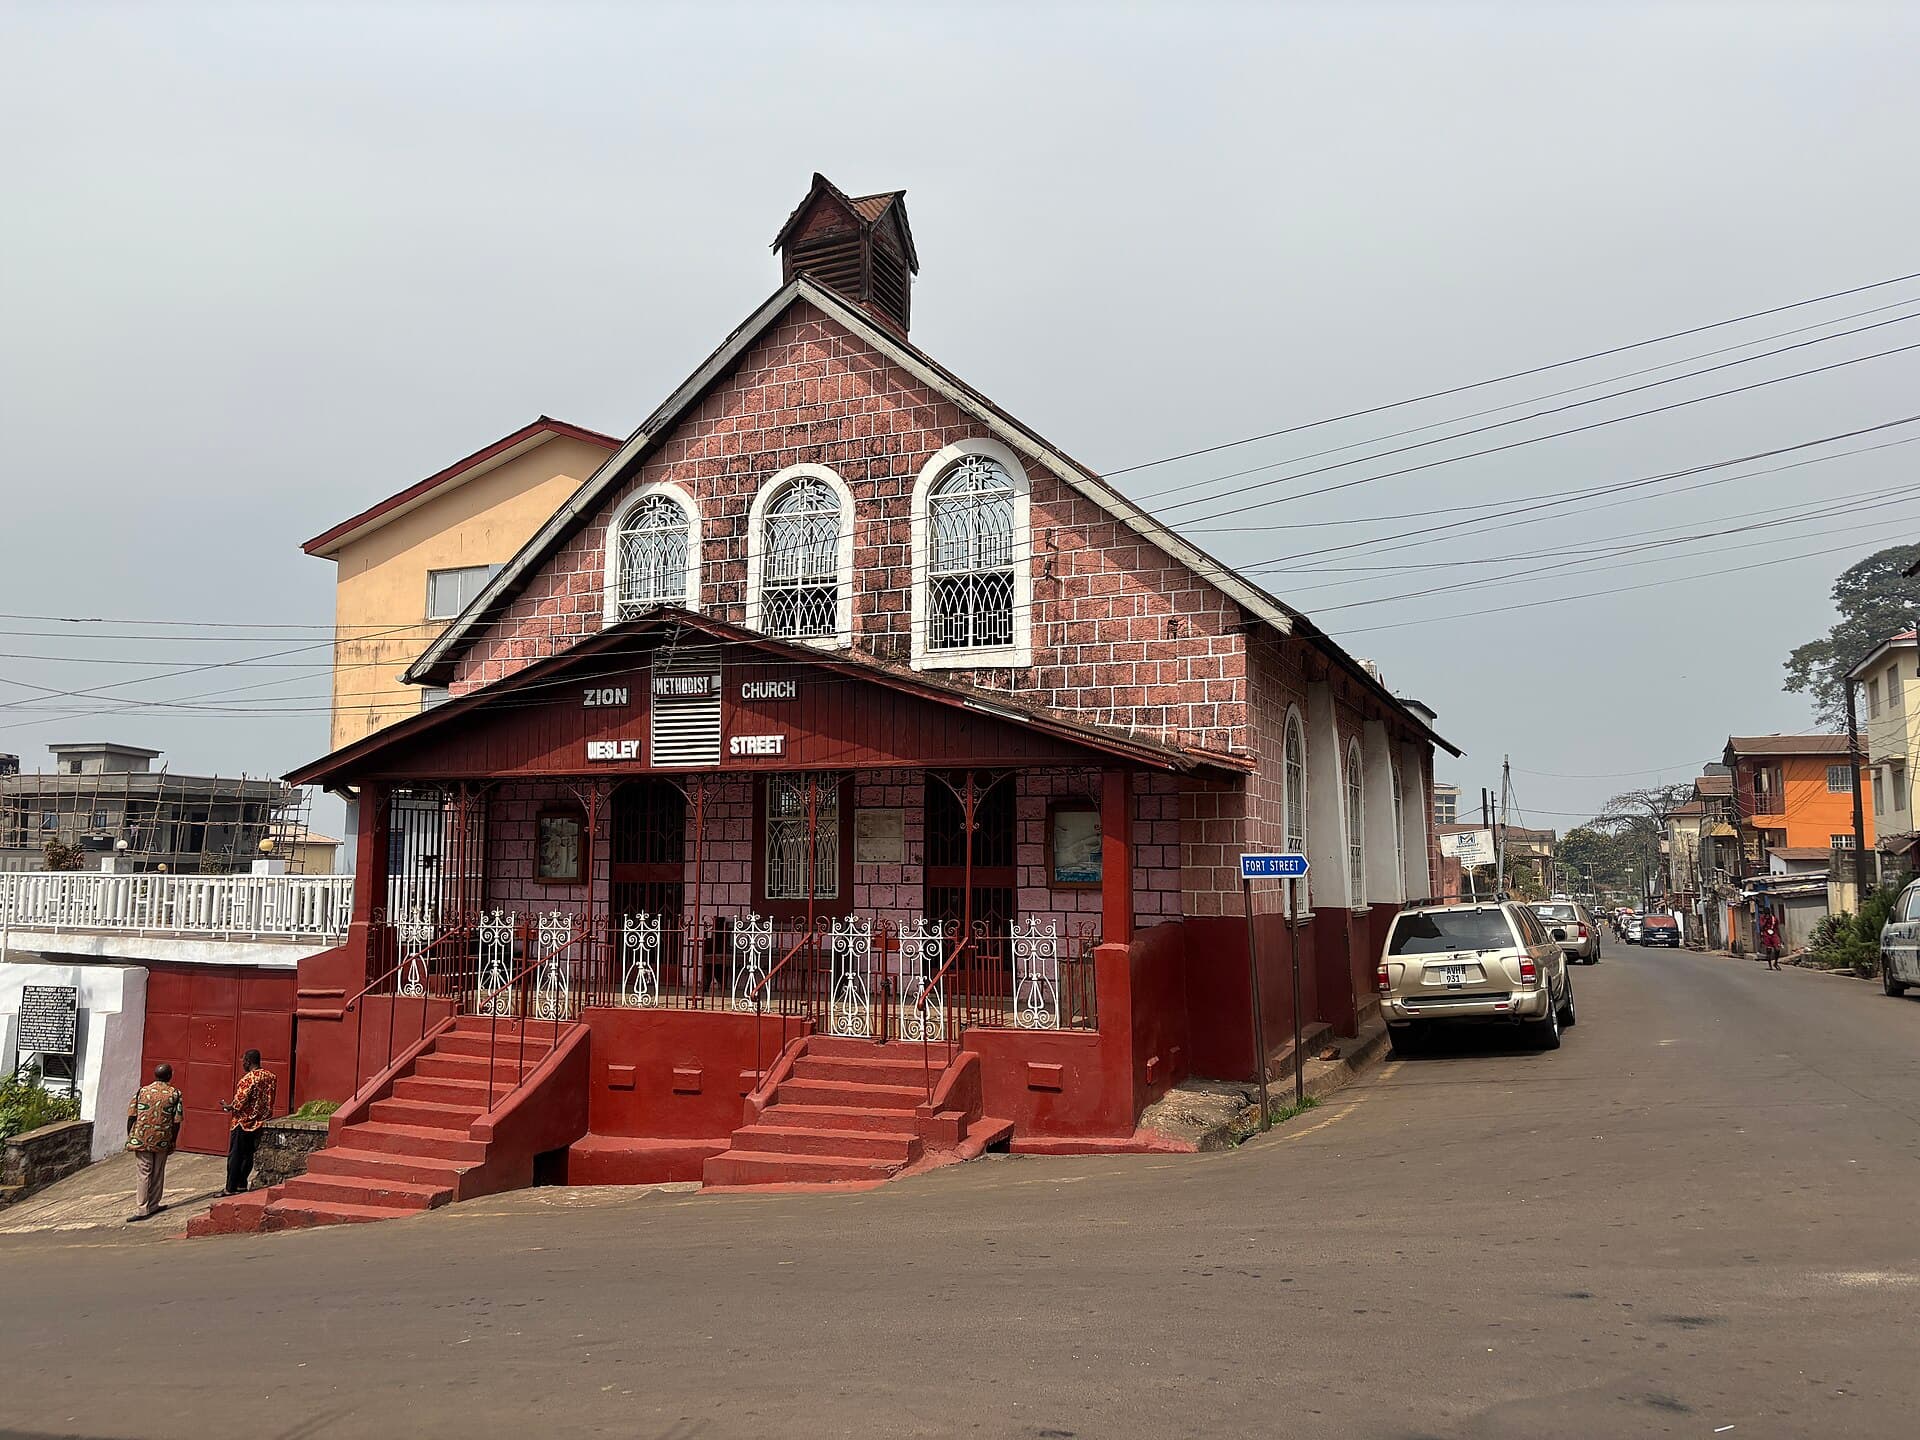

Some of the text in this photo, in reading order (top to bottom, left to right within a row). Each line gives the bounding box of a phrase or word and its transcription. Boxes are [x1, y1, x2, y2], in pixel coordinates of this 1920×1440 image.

[583, 677, 796, 706] ZION METHODIST CHURCH
[587, 735, 785, 760] WESLEY STREET
[1245, 860, 1299, 872] FORT STREET
